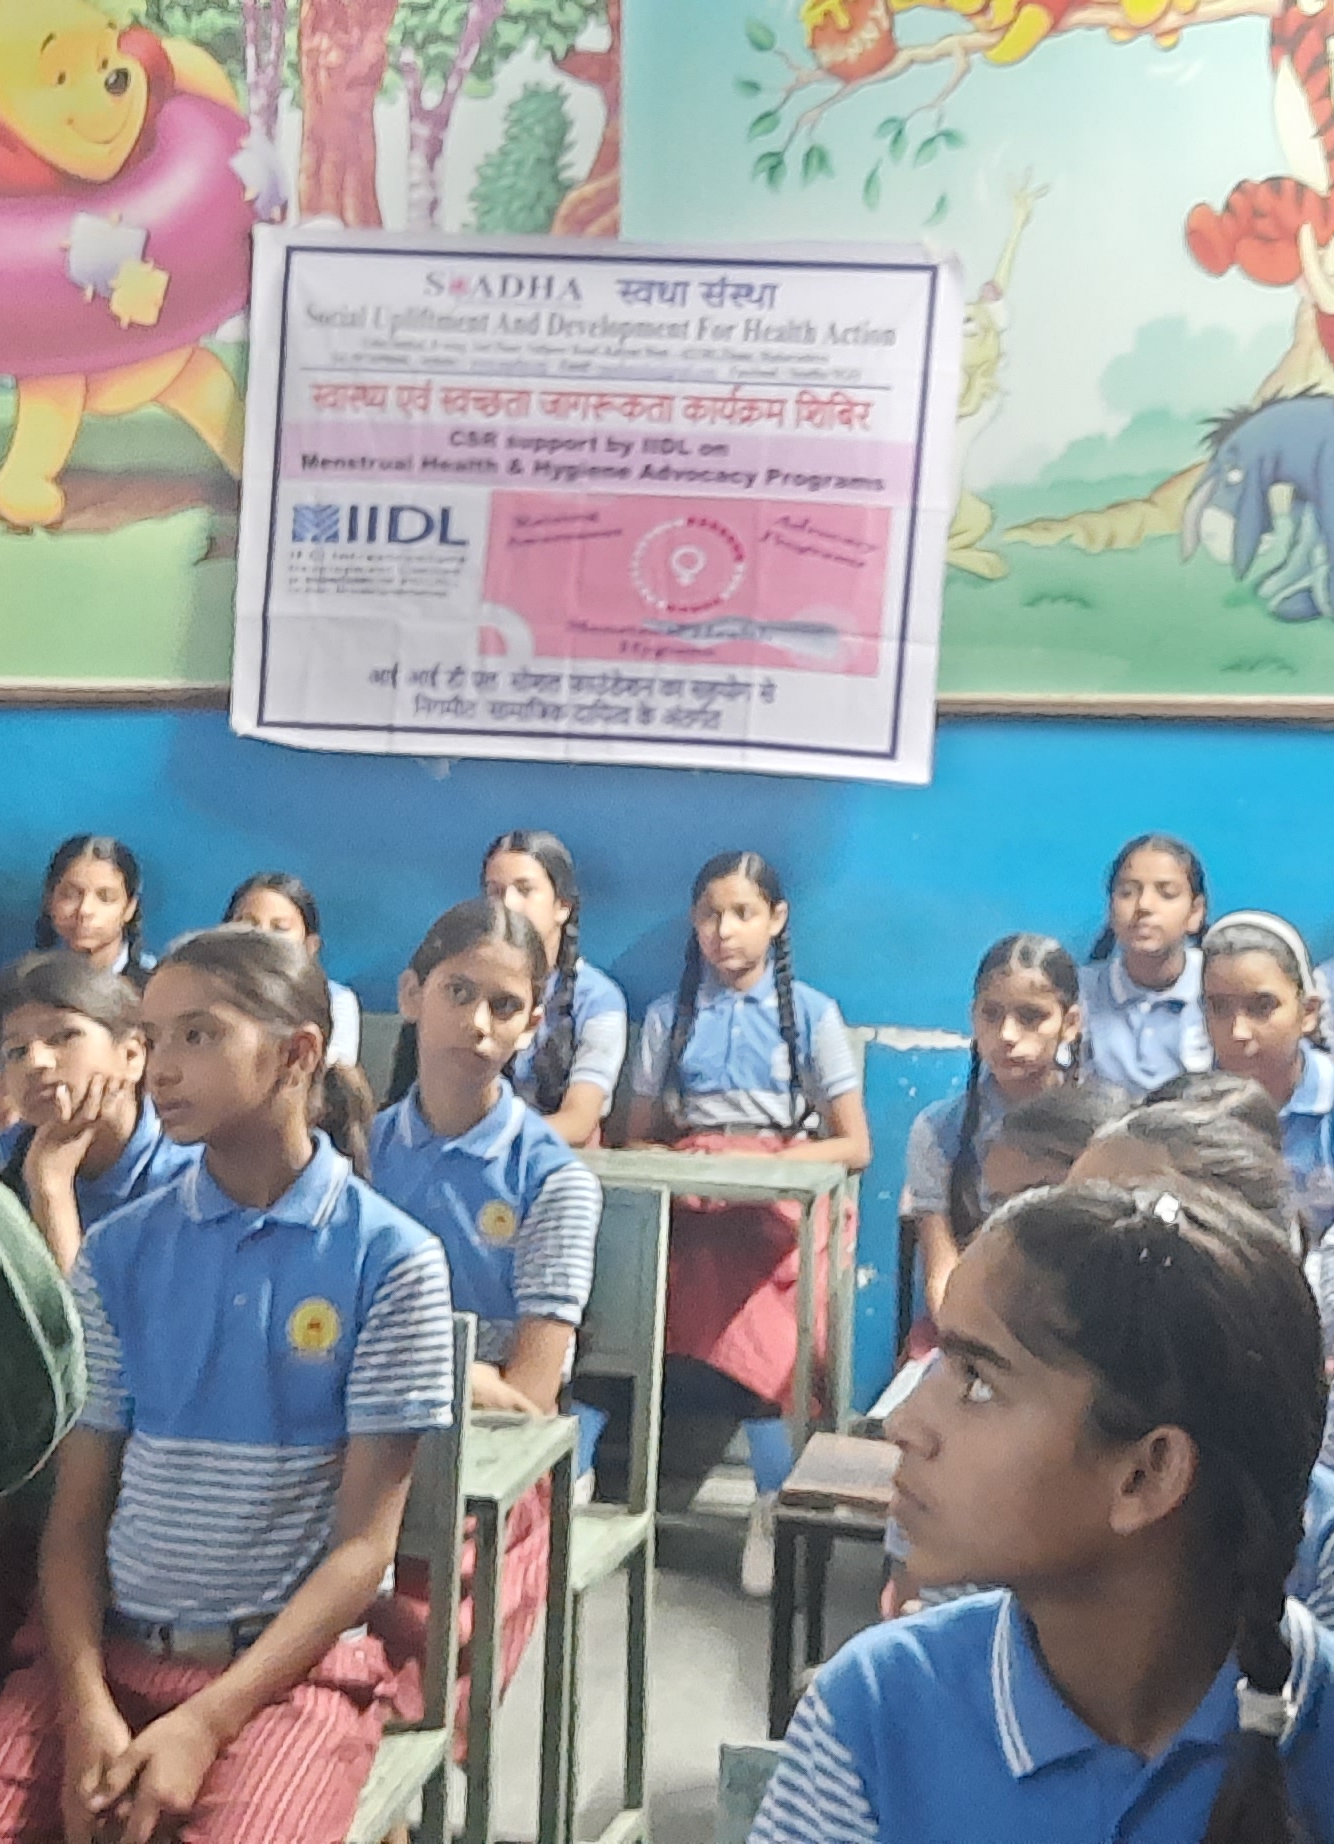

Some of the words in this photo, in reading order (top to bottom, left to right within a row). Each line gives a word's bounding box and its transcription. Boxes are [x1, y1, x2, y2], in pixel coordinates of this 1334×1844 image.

[496, 311, 540, 336] And
[547, 311, 690, 345] Development
[697, 316, 735, 341] For
[742, 318, 817, 345] Health
[822, 321, 897, 347] Action
[450, 430, 497, 447] CSR
[506, 434, 598, 453] support
[605, 437, 635, 458] by
[301, 454, 413, 473] Menstrual
[421, 455, 499, 474] Health
[505, 458, 525, 475] &
[532, 459, 632, 481] Hygiene
[637, 463, 759, 489] Advocacy
[765, 468, 886, 492] Programs
[347, 504, 469, 547] IIDL
